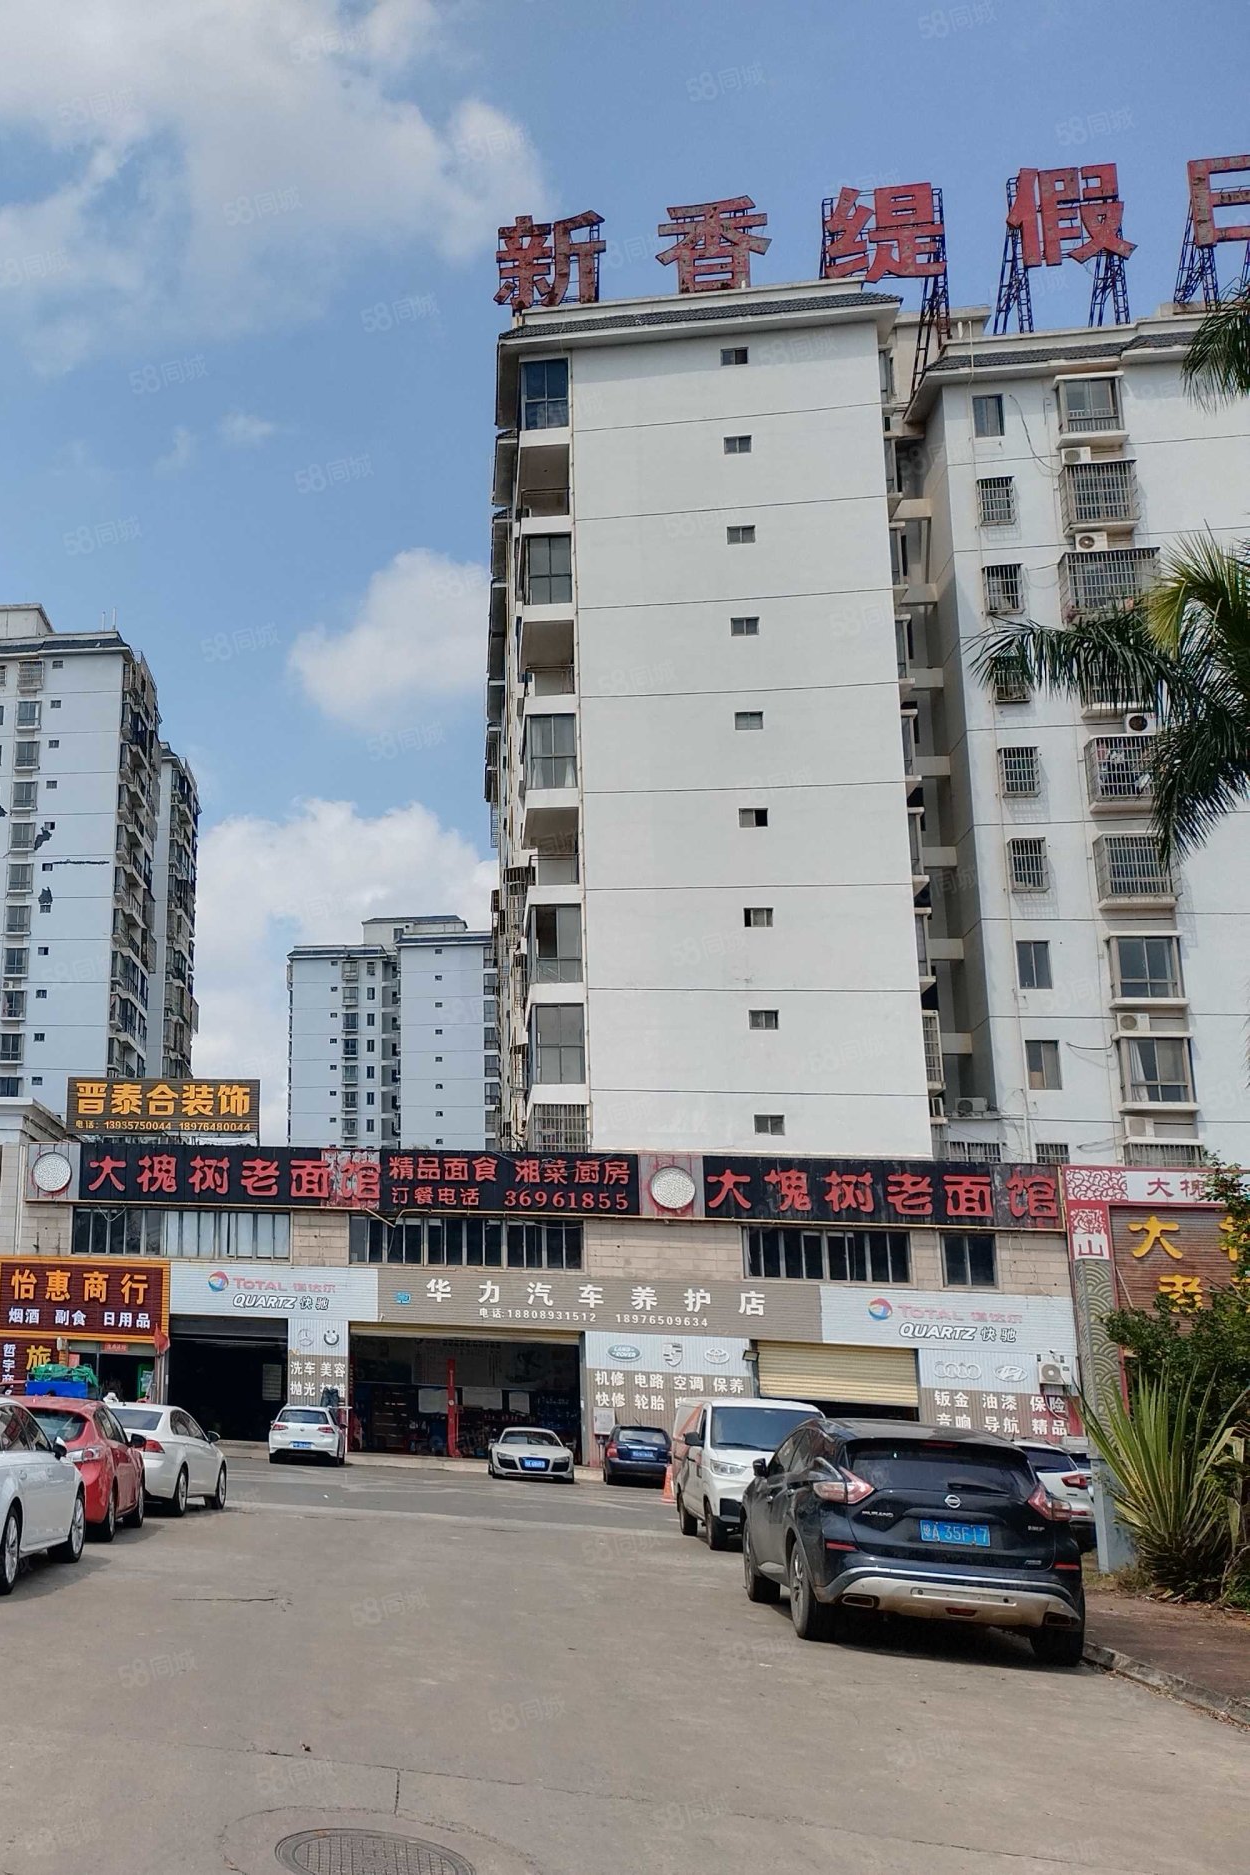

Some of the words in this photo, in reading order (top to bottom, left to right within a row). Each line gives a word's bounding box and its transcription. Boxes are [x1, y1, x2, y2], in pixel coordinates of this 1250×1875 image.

[76, 1082, 251, 1117] 晋泰合装饰
[88, 1153, 382, 1201] 大槐树老面馆
[388, 1156, 499, 1183] 精品面食
[514, 1157, 631, 1186] 湘菜厨房
[391, 1186, 480, 1207] 订餐电话
[504, 1189, 629, 1210] 36961855
[707, 1167, 1059, 1219] 大槐树老面馆
[11, 1269, 150, 1305] 怡惠商行
[426, 1278, 765, 1316] 华力汽车养护店
[232, 1293, 297, 1309] QUARTZ
[8, 1307, 40, 1325] 烟酒
[55, 1309, 87, 1327] 副食
[103, 1311, 151, 1329] 日用品
[615, 1314, 708, 1327] 18976509634
[899, 1322, 977, 1341] QUARTZ
[980, 1326, 1017, 1343] 快驰
[290, 1361, 316, 1376] 洗车
[320, 1361, 346, 1378] 美容
[594, 1370, 625, 1387] 机修
[634, 1373, 664, 1390] 电路
[673, 1375, 704, 1392] 空调
[713, 1377, 745, 1395] 保养
[595, 1392, 626, 1408] 快修
[634, 1394, 665, 1411] 轮胎
[934, 1390, 970, 1409] 钣金
[982, 1393, 1018, 1411] 油漆
[1030, 1395, 1067, 1414] 保险
[984, 1416, 1020, 1434] 导航
[1031, 1418, 1068, 1437] 精品
